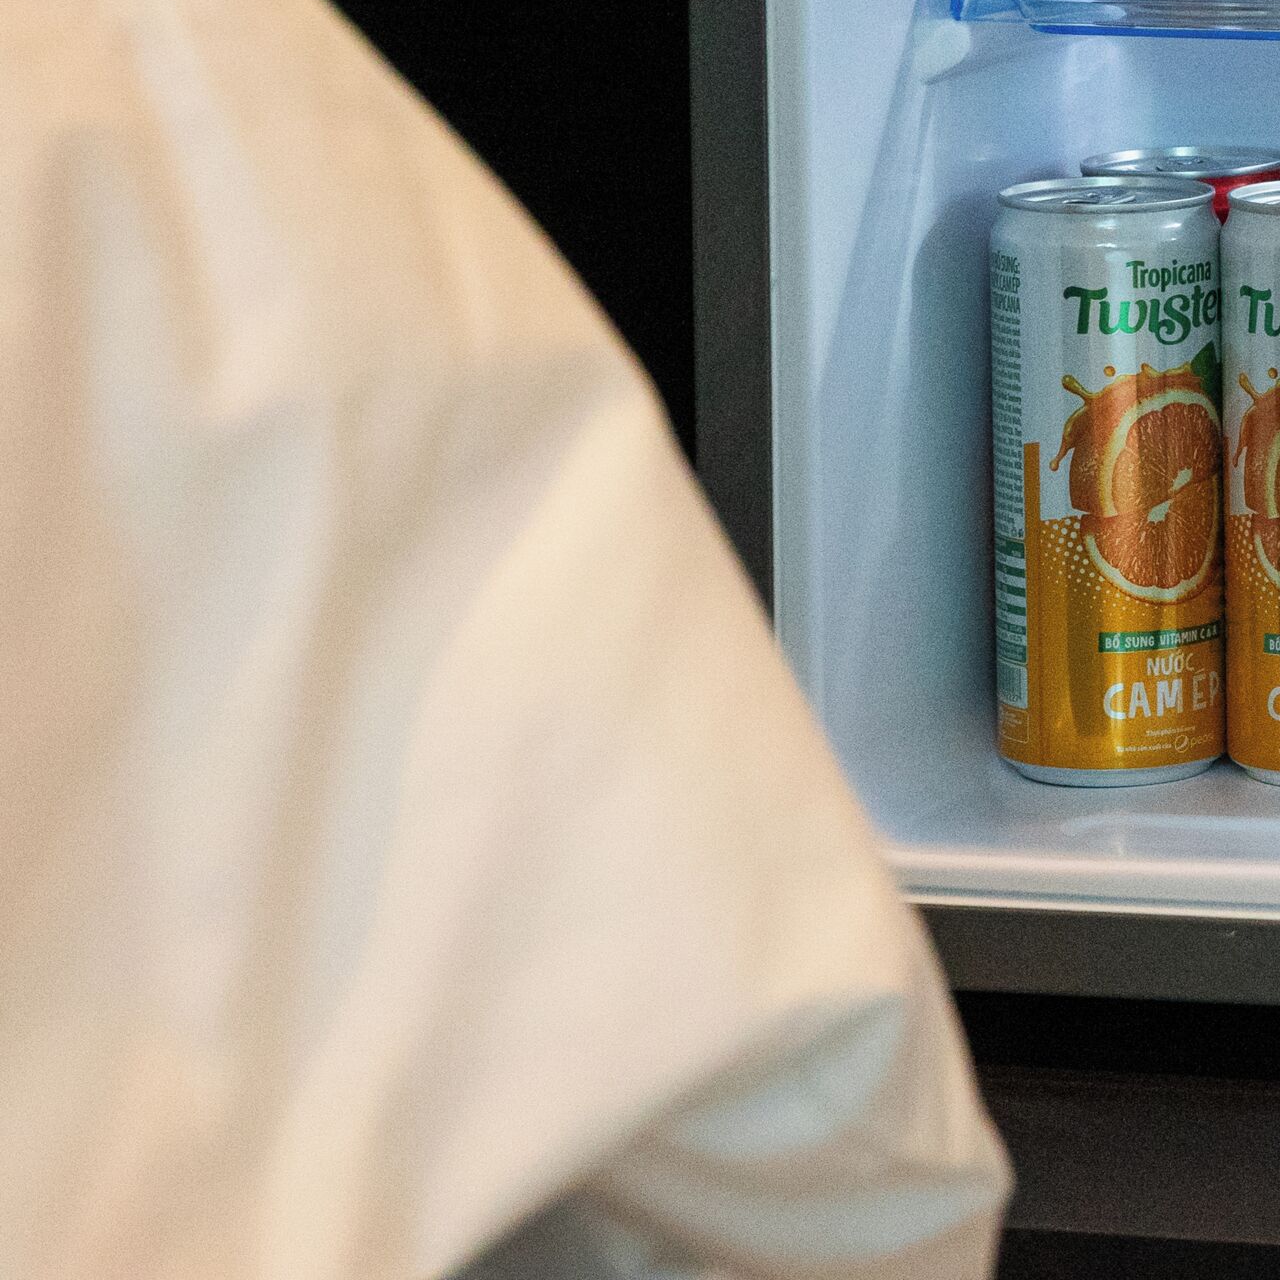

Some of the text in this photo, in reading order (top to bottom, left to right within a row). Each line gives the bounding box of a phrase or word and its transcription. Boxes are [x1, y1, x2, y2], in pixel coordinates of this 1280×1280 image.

[1126, 259, 1211, 292] Tropicana
[1124, 636, 1155, 649] SUNG
[1160, 629, 1198, 646] VITAMIN
[1104, 679, 1184, 720] CAM
